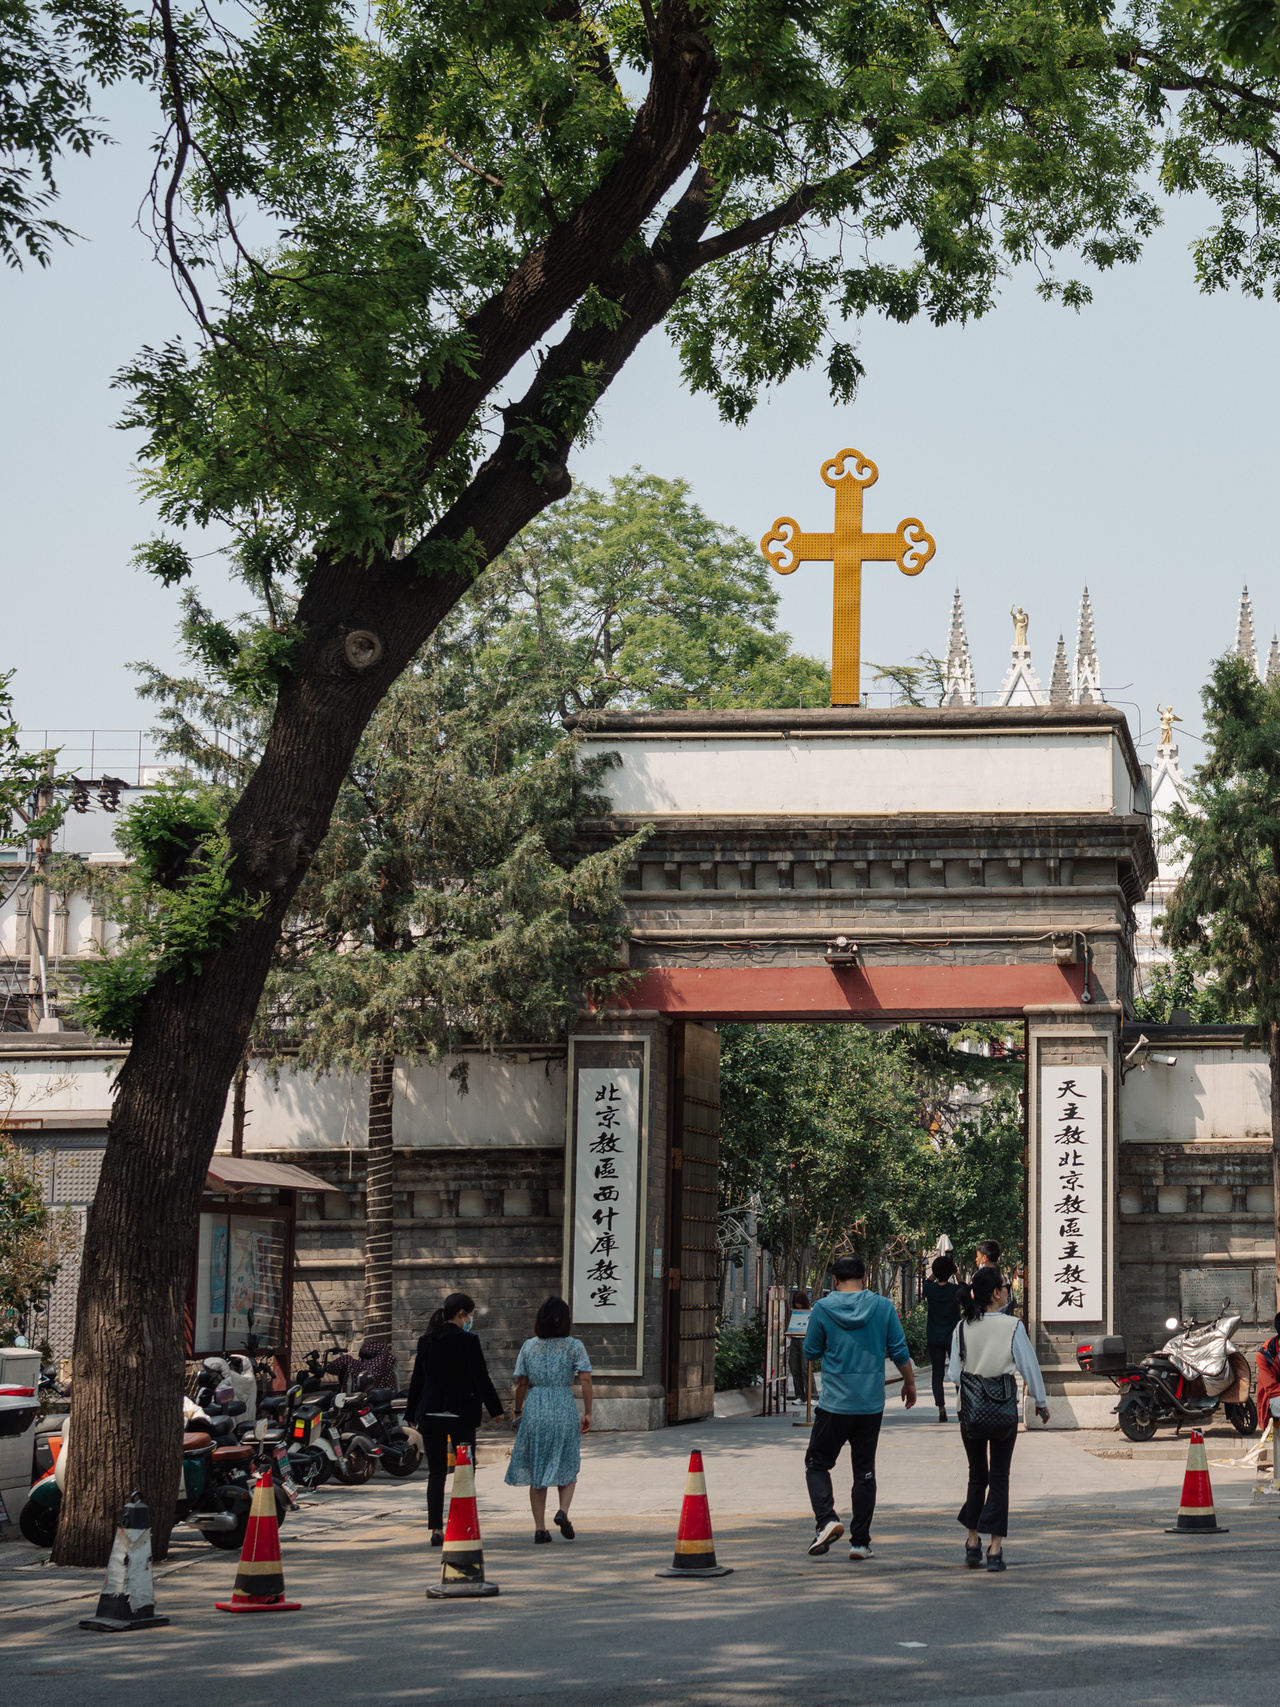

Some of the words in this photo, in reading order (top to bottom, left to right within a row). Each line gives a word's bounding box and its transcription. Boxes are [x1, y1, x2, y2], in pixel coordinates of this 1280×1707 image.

[587, 1082, 624, 1308] 北京教區西什庫教堂
[1054, 1079, 1089, 1309] 天主教北京教區主教府
